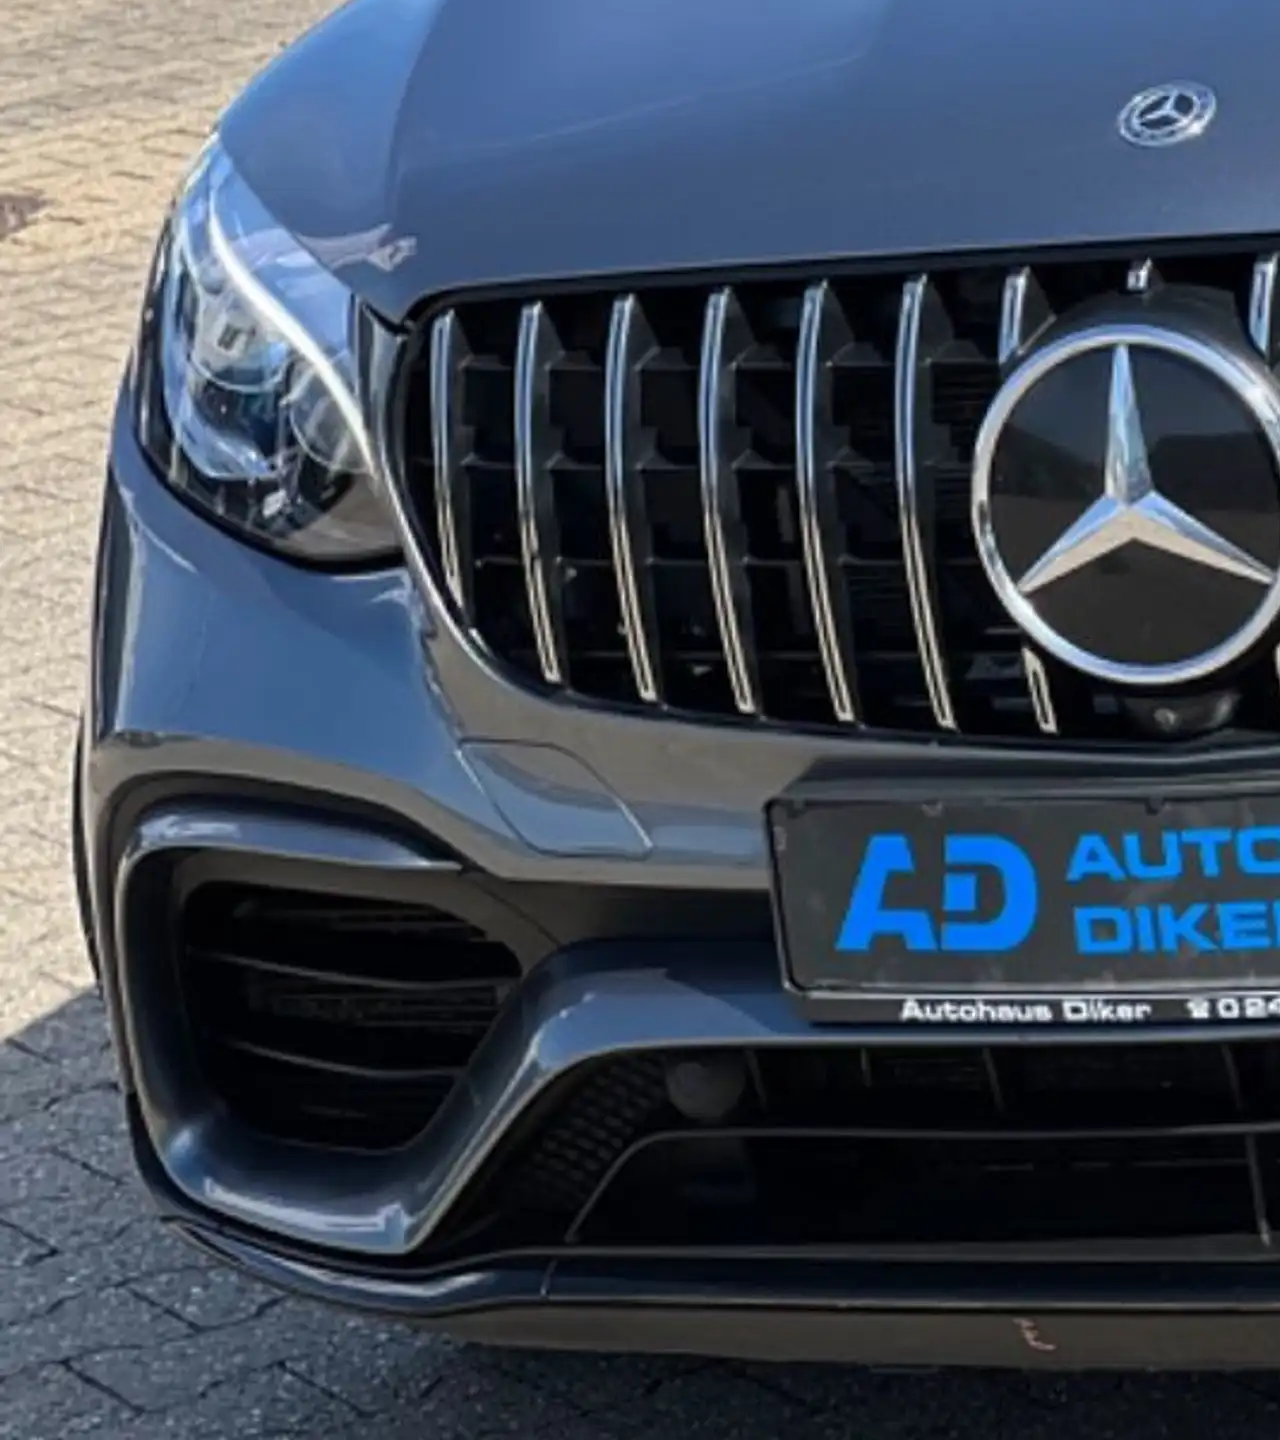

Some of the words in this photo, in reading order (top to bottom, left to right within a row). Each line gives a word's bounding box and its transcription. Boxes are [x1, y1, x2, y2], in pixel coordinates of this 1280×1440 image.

[835, 833, 1039, 953] AD
[900, 997, 1053, 1023] Autohaus
[1062, 998, 1153, 1022] Diker
